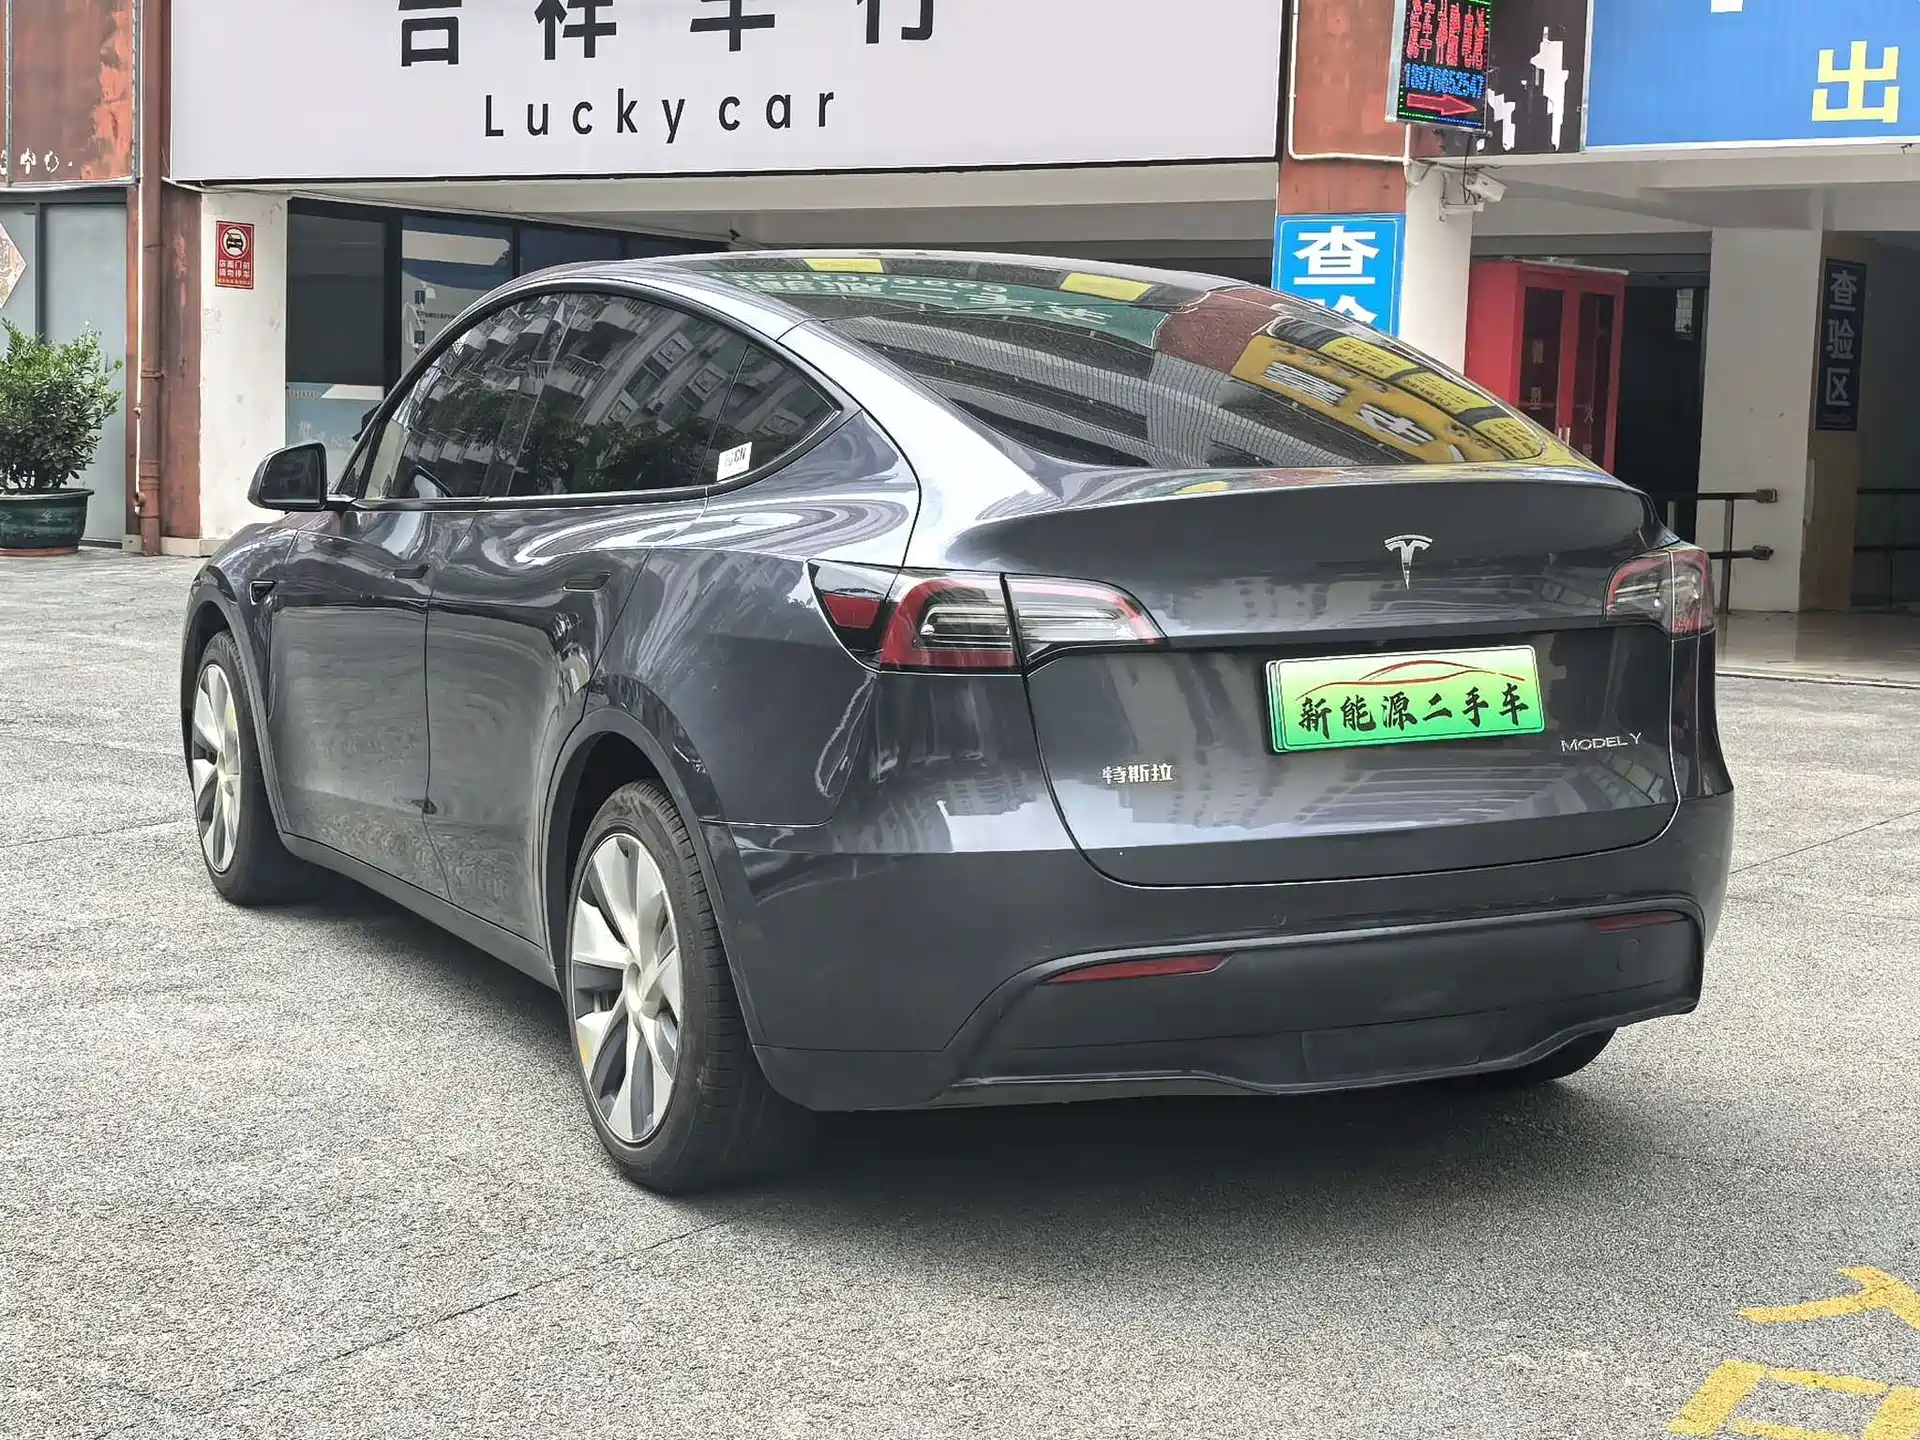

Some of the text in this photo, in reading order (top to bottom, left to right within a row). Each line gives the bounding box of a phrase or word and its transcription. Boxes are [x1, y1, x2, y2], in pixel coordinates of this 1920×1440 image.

[1811, 40, 1900, 124] 出
[485, 88, 835, 144] Lucky car
[1825, 270, 1857, 407] 查验区
[1298, 683, 1529, 740] 新能源二手车
[1560, 731, 1642, 752] MODEL Y
[1102, 763, 1174, 785] 特斯拉
